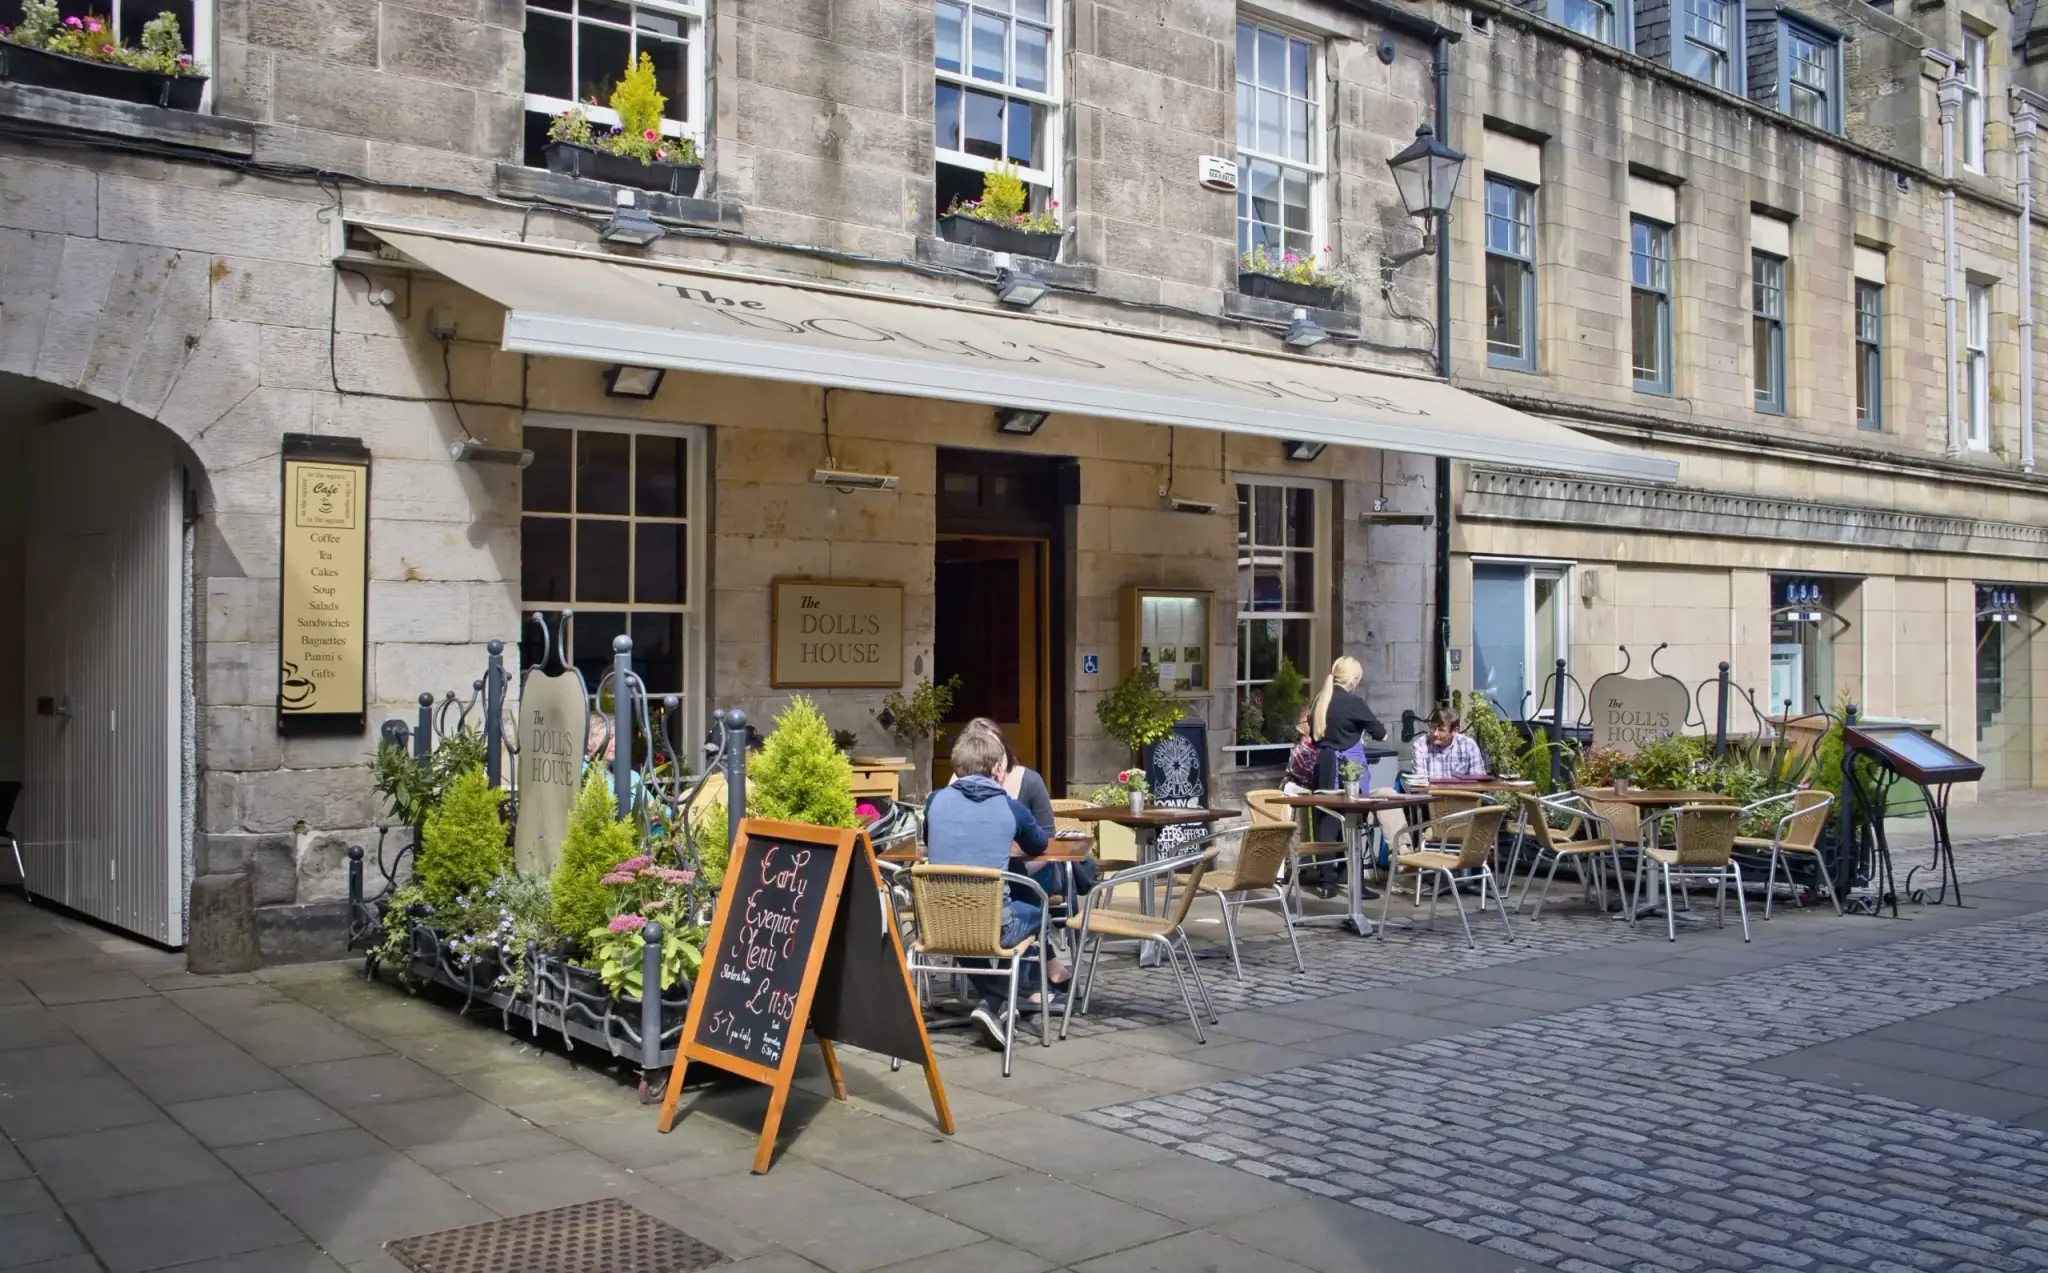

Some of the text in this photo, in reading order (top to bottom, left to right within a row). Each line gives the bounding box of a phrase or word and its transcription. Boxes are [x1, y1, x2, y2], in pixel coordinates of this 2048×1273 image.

[657, 282, 767, 311] The
[310, 532, 341, 543] Coffee
[318, 550, 333, 560] Tea
[310, 567, 339, 577] Cakes
[312, 584, 336, 597] Soup
[1788, 584, 1820, 599] TSB
[308, 600, 339, 611] Salads
[800, 595, 820, 609] The
[297, 617, 350, 628] Sandwiches
[800, 613, 880, 635] DOLL'S
[301, 635, 347, 648] Baguettes
[800, 642, 880, 664] HOUSE
[311, 668, 335, 679] Gifts
[1608, 698, 1624, 709] The
[533, 710, 545, 725] The
[1608, 710, 1670, 728] DOLL'S
[531, 757, 574, 787] HOUSE
[761, 846, 811, 914] Early
[746, 889, 800, 959] Evening
[731, 925, 777, 972] Menu
